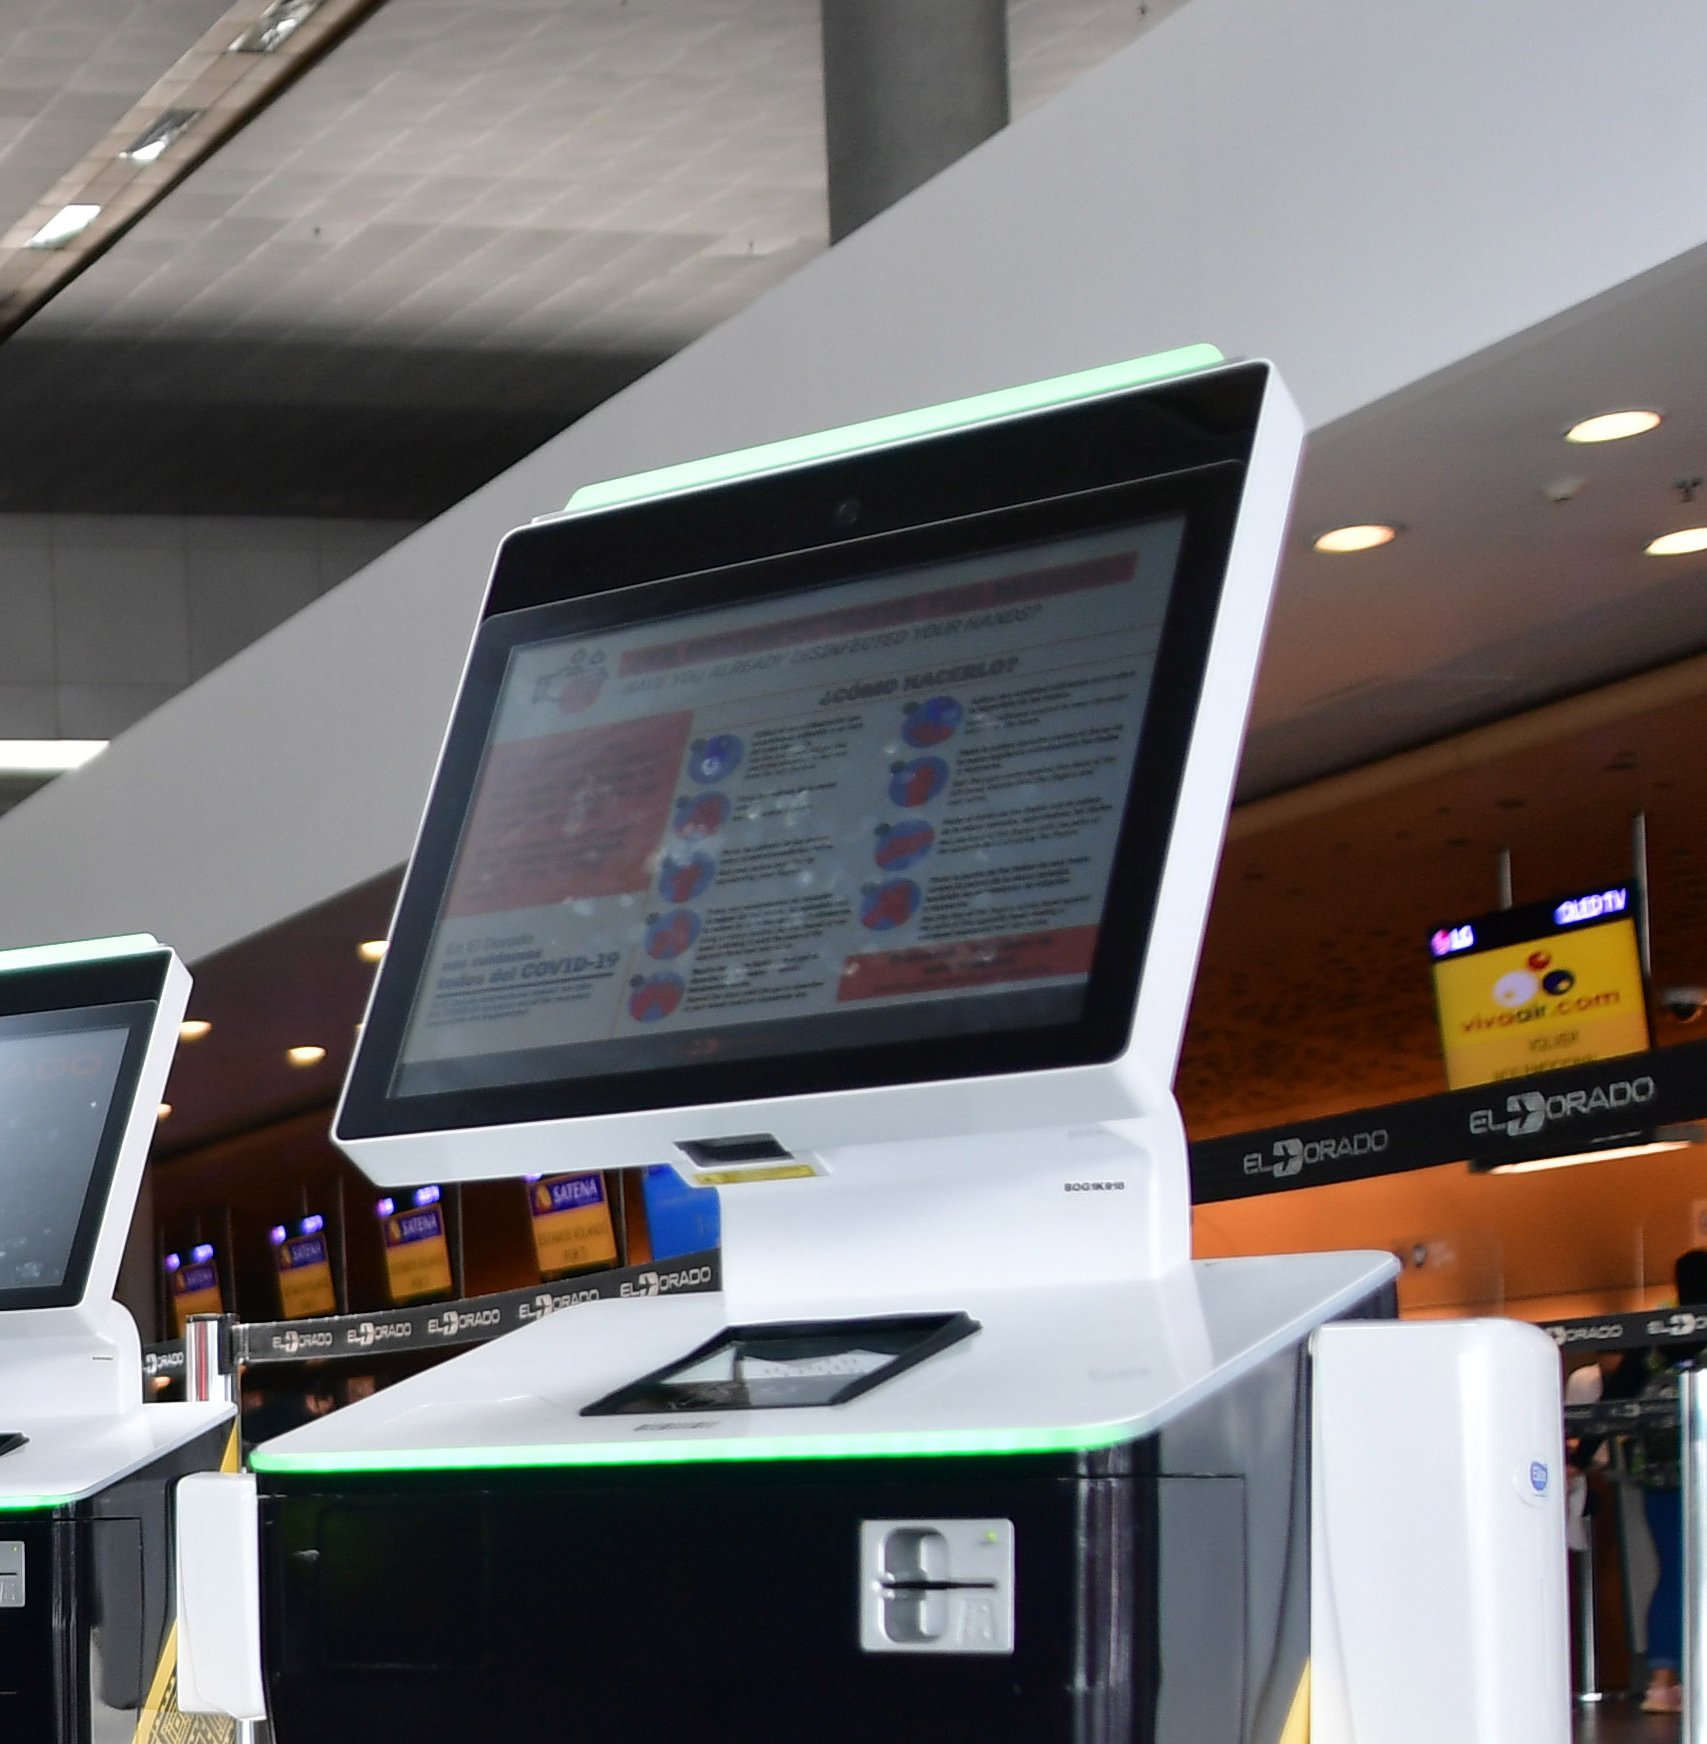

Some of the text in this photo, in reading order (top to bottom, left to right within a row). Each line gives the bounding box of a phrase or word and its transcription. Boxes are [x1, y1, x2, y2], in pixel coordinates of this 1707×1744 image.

[521, 950, 621, 980] COVID-19
[553, 1179, 599, 1204] SATENA
[400, 1210, 438, 1235] SATENA
